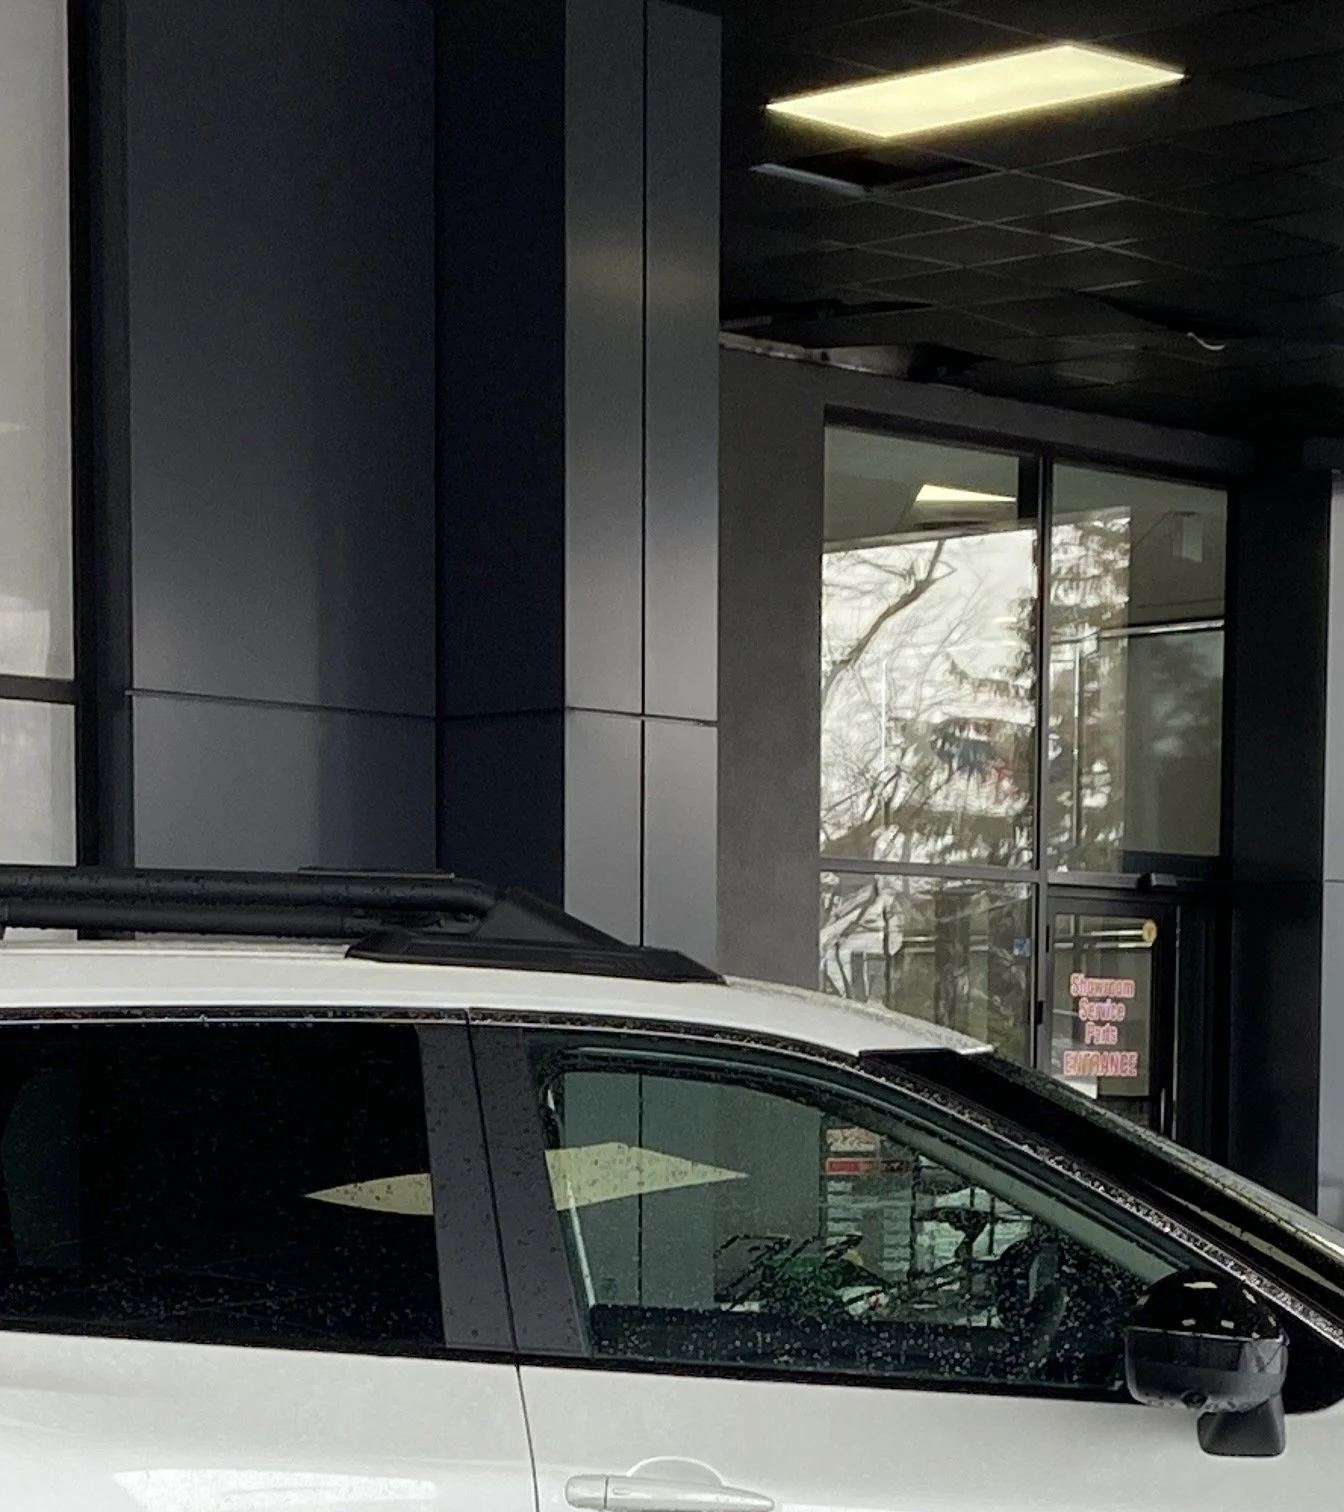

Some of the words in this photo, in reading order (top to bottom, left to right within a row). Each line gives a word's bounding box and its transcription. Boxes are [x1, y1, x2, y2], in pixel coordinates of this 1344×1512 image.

[1070, 973, 1135, 998] Showroom
[1079, 997, 1126, 1022] Service
[1085, 1021, 1118, 1045] Parts
[1063, 1051, 1138, 1077] ENTRANCE
